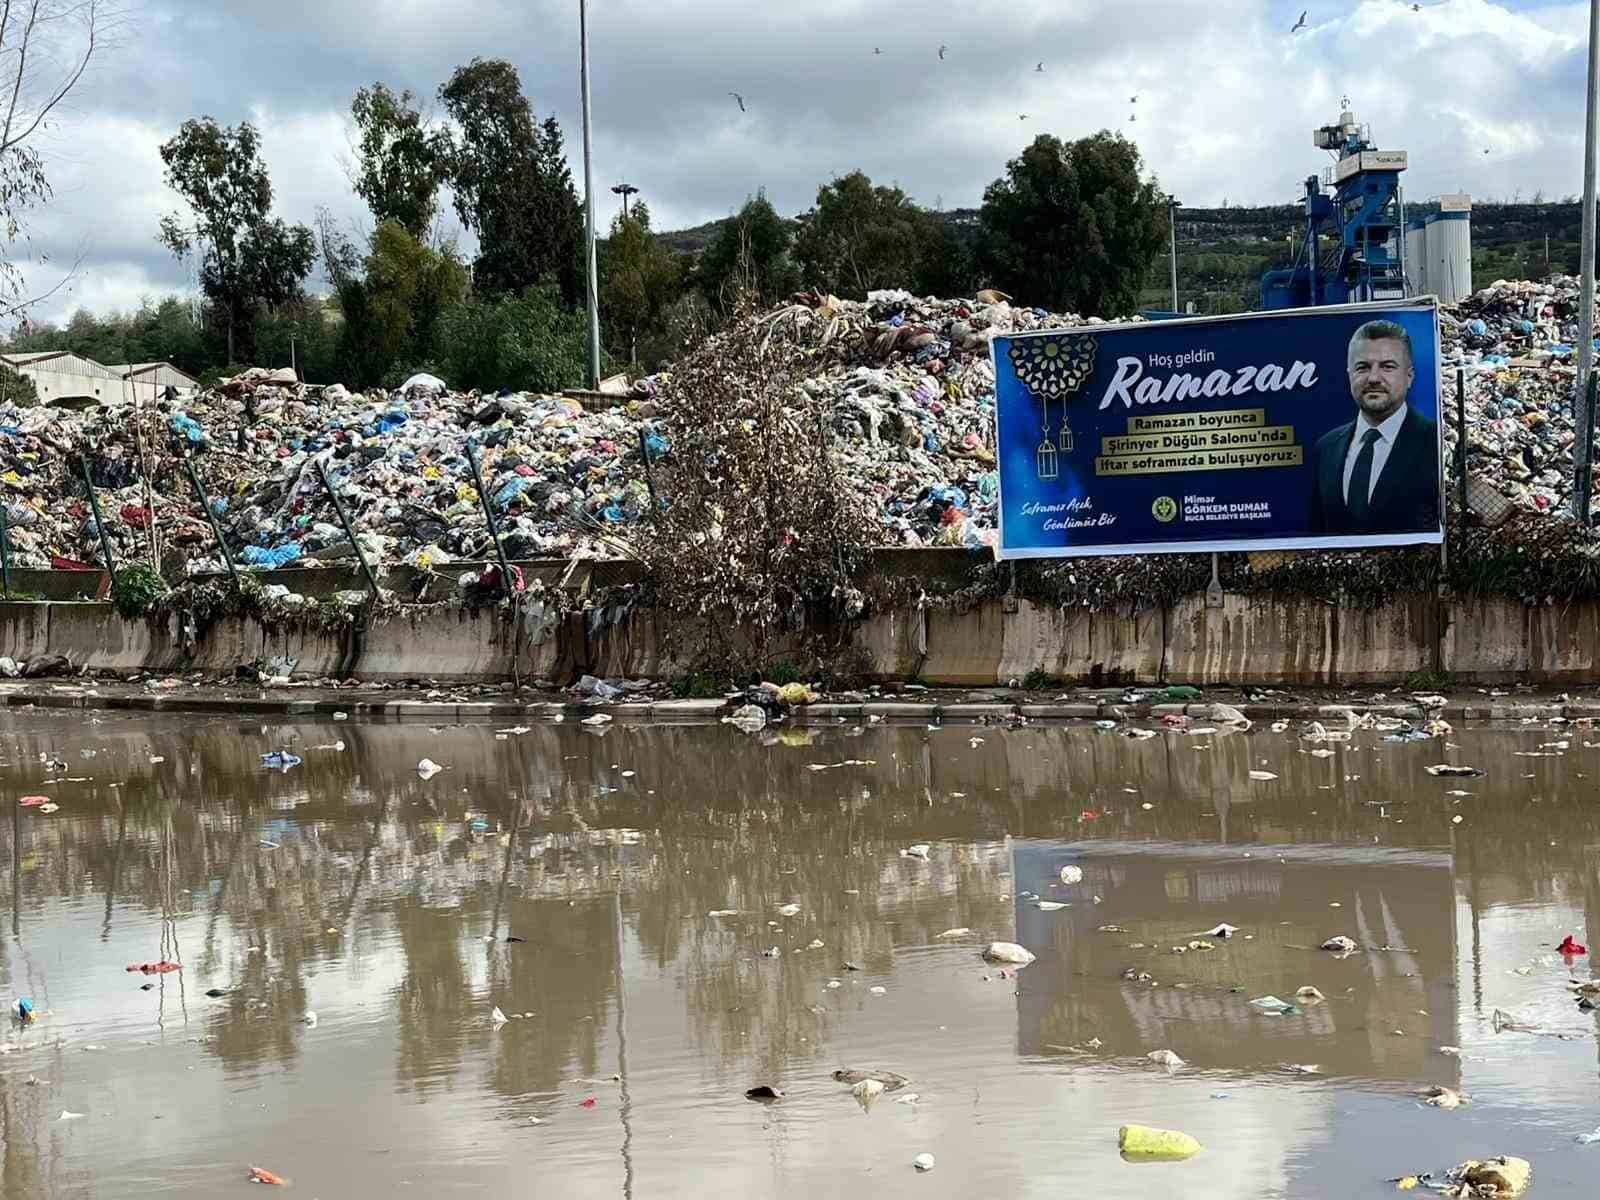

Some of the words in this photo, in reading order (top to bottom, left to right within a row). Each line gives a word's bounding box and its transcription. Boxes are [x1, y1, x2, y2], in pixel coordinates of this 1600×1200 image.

[1149, 354, 1173, 368] Hoş
[1176, 349, 1215, 367] geldin
[1099, 356, 1318, 410] Ramazan
[1135, 416, 1195, 430] Ramazan
[1199, 413, 1257, 427] boyunca
[1108, 437, 1159, 454] Şirinyer
[1162, 433, 1207, 449] Düğün
[1210, 429, 1287, 446] Salonu'nda
[1132, 455, 1204, 469] soframızda
[1184, 503, 1228, 514] GÖRKEM
[1230, 502, 1269, 512] DUMAN
[1097, 513, 1117, 526] Bir
